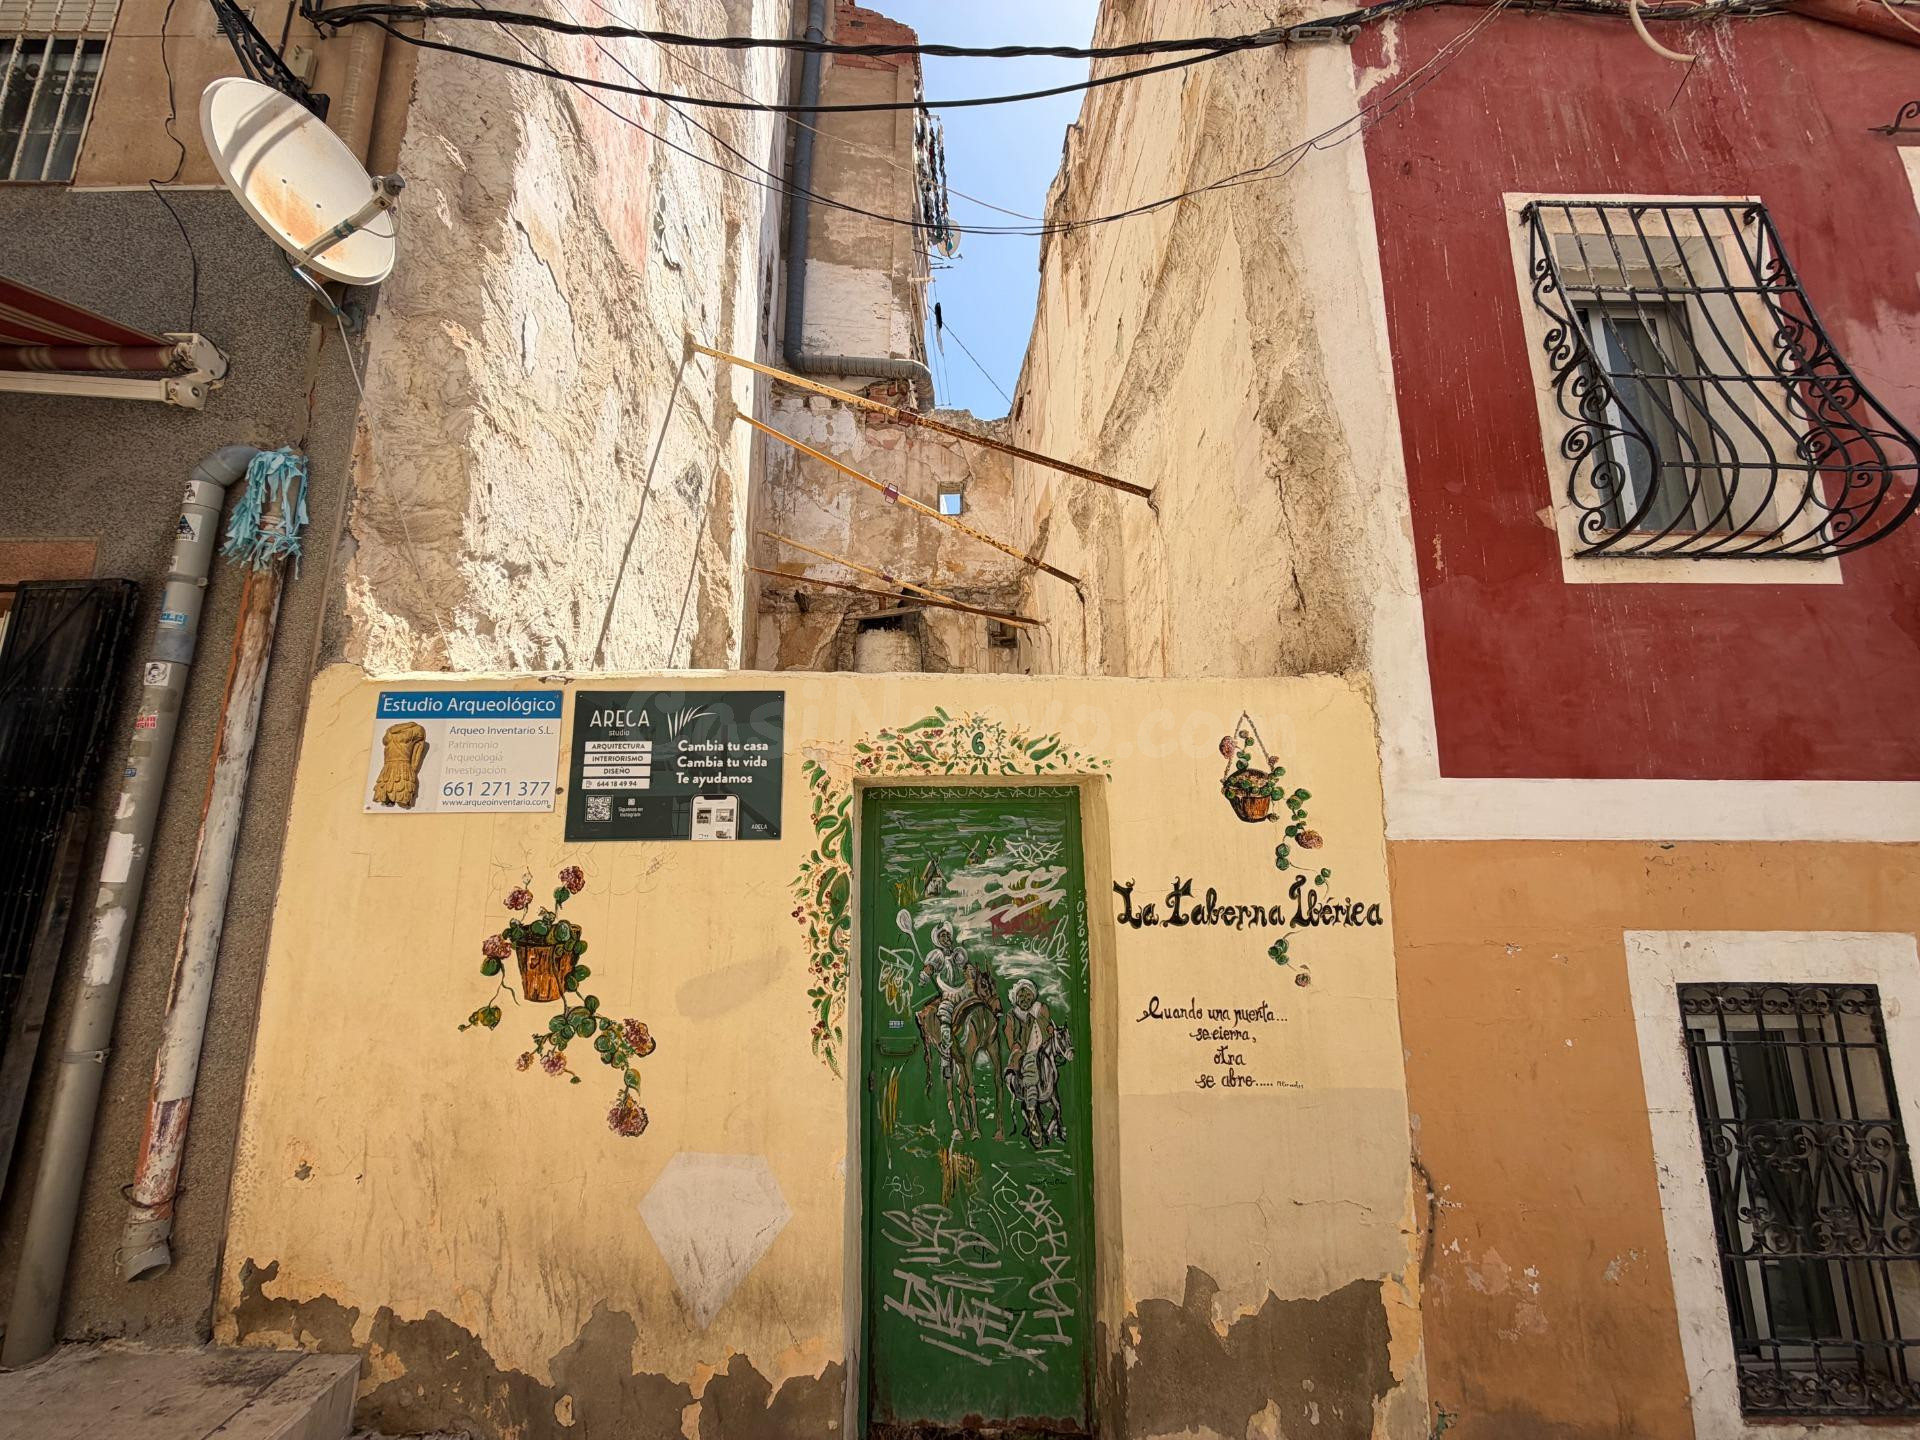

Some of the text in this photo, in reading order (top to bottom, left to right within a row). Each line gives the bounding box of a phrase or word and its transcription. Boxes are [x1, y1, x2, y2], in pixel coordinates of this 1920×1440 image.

[383, 697, 556, 715] Estudio Arqueológico
[589, 709, 651, 728] ARECA
[449, 726, 554, 737] Arqueo Inventario S.L.
[608, 729, 631, 737] studio
[448, 740, 500, 750] Patrimonio
[591, 743, 646, 751] ARQUITECTURA
[677, 739, 769, 752] Cambia tu casa
[971, 731, 986, 755] 6
[446, 751, 503, 763] Arqueología
[676, 755, 768, 768] Cambia tu vida
[445, 766, 507, 776] Investigación
[603, 766, 631, 775] DISEÑO
[675, 772, 753, 788] Te ayudamos
[443, 781, 550, 797] 661 271 377
[442, 799, 549, 807] www.arqueoinventario.com
[1113, 877, 1159, 929] La
[1160, 876, 1286, 931] Taberna
[1289, 874, 1384, 929] Ibérica
[1136, 996, 1203, 1022] Cuando
[1207, 1007, 1230, 1022] una
[1213, 1045, 1247, 1065] otra
[1195, 1073, 1216, 1088] se
